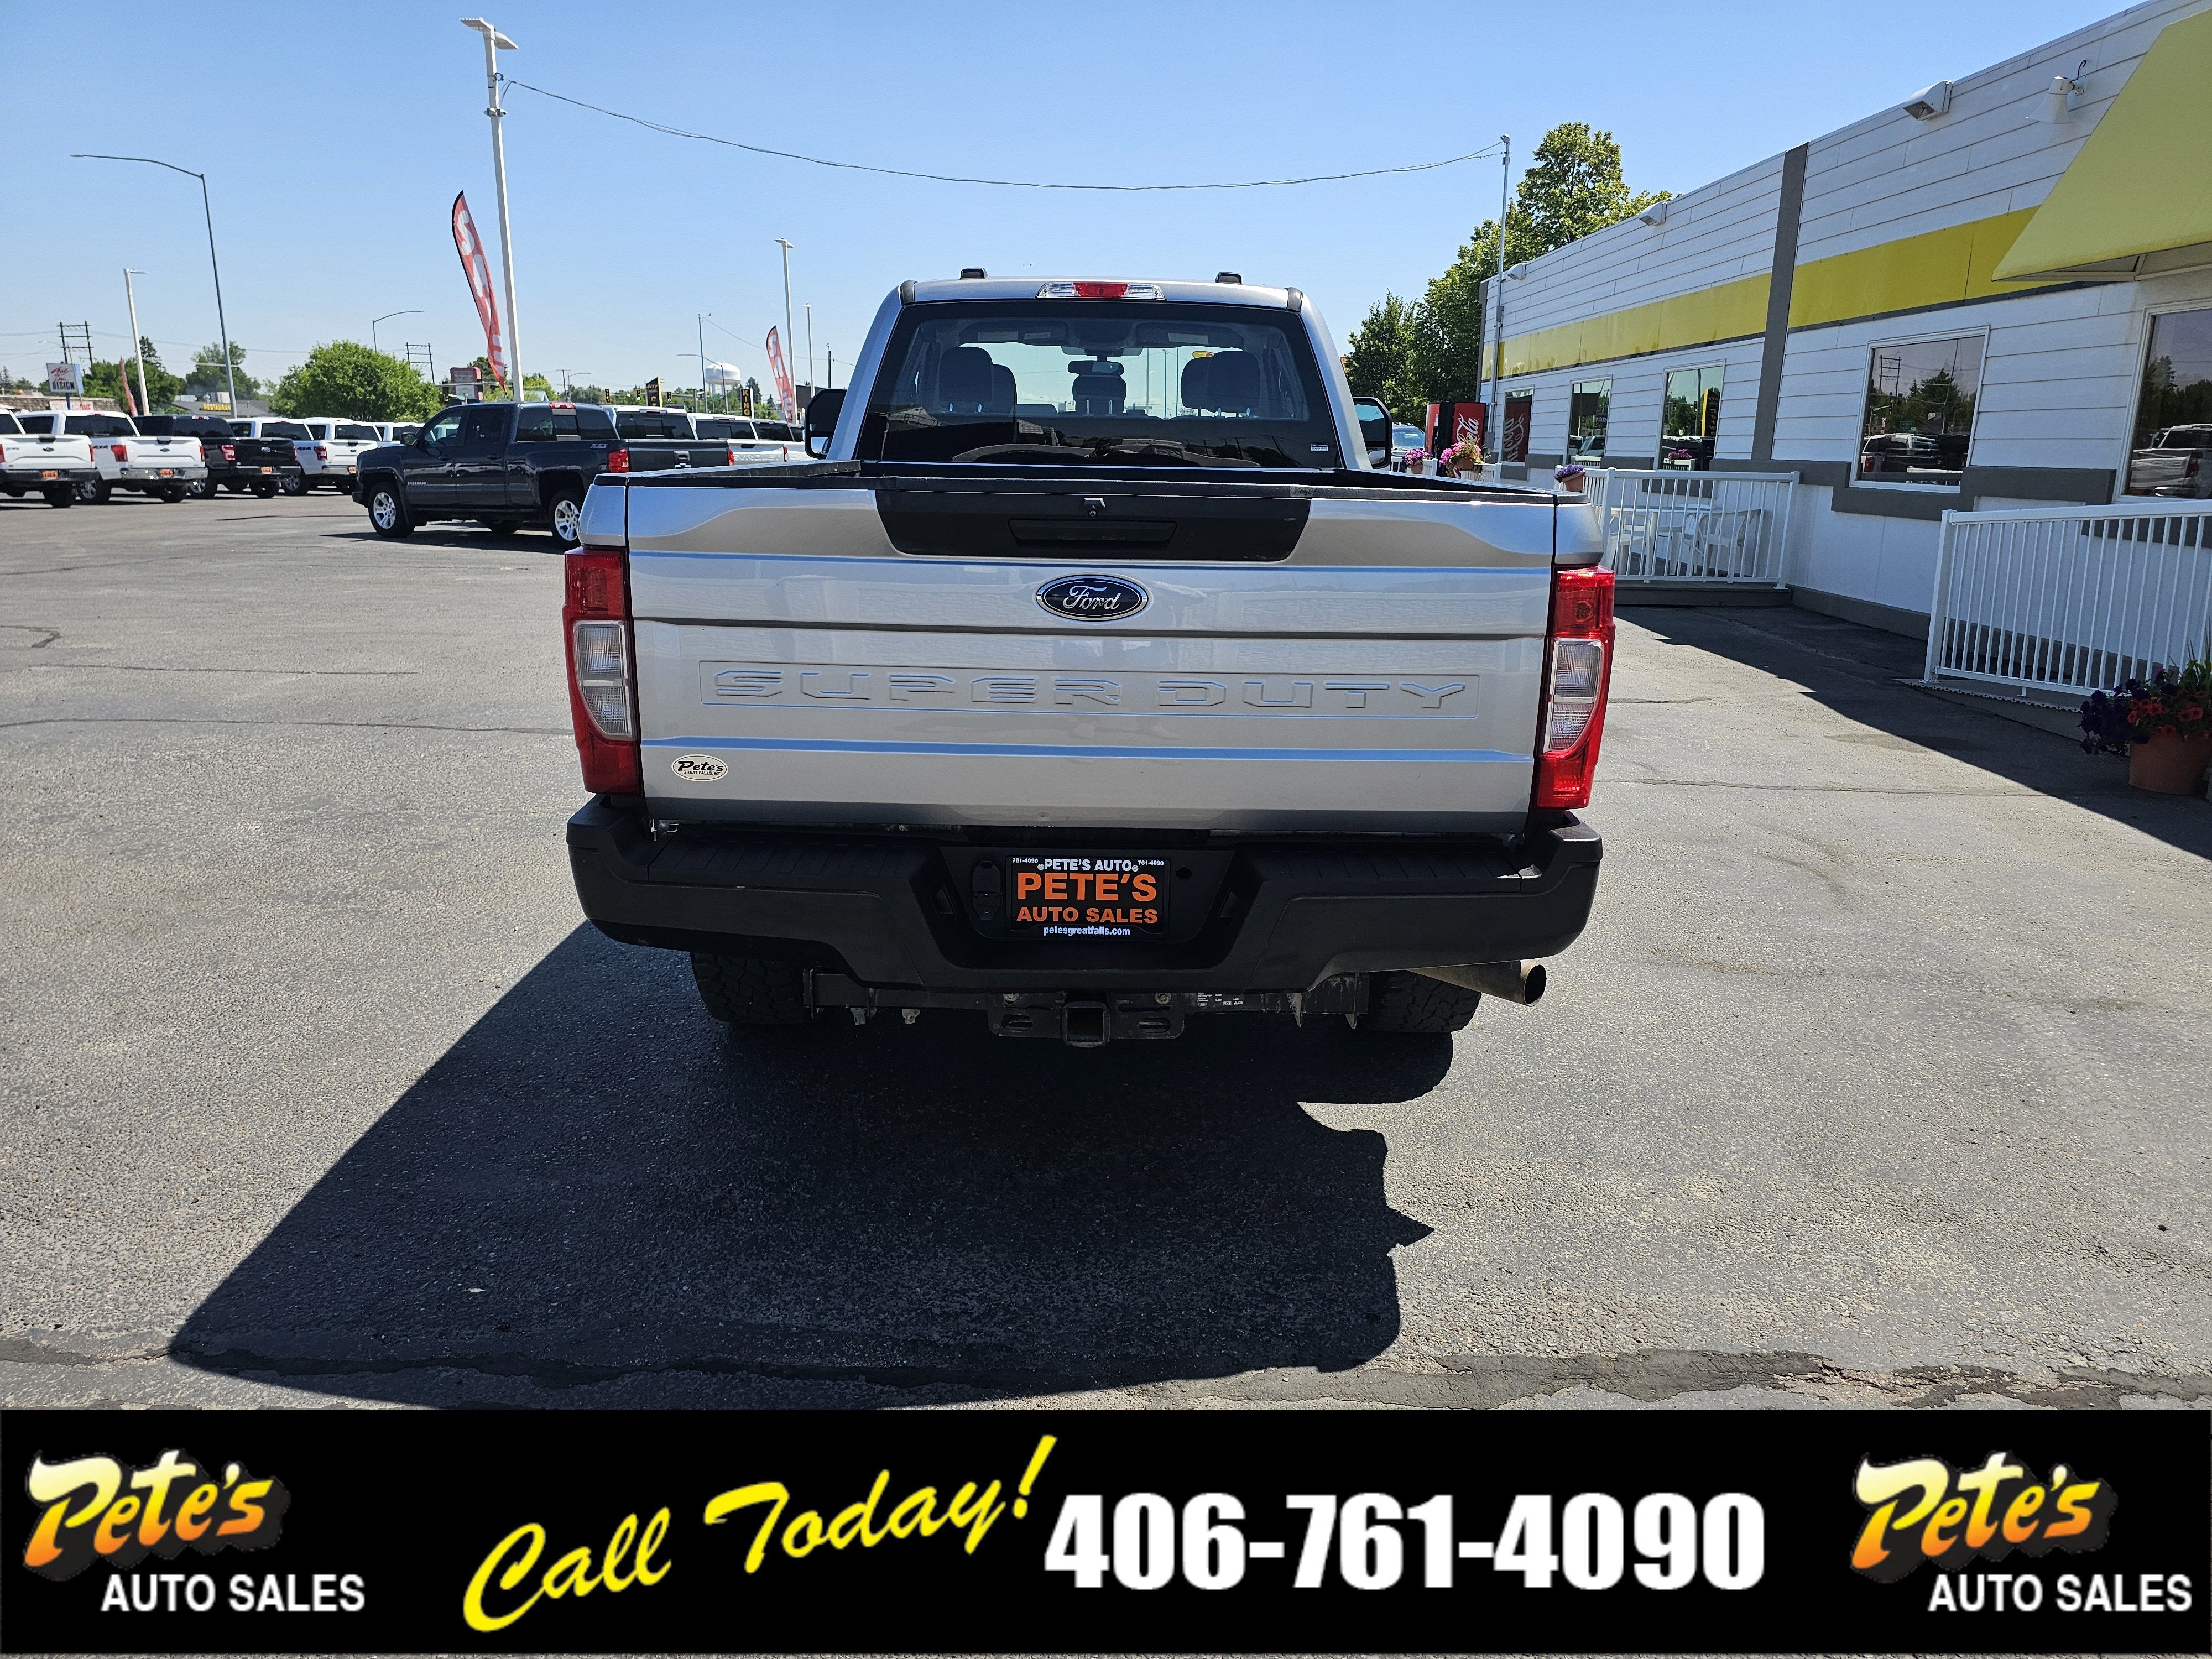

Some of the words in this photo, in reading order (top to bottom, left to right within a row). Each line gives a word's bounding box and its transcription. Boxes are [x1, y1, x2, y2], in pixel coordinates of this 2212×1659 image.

[53, 382, 75, 390] DESIGN
[203, 403, 231, 411] RESTAURAN
[1062, 585, 1121, 609] Ford
[715, 670, 1120, 706] SUPER
[1158, 680, 1466, 709] DUTY
[677, 760, 724, 771] Pete's
[1044, 859, 1091, 871] PETE'S
[1094, 860, 1131, 872] AUTO
[1018, 872, 1157, 902] PETE'S
[1016, 906, 1078, 922] AUTO
[1086, 907, 1158, 924] SALES
[1044, 926, 1130, 936] petesgreatfalls.com
